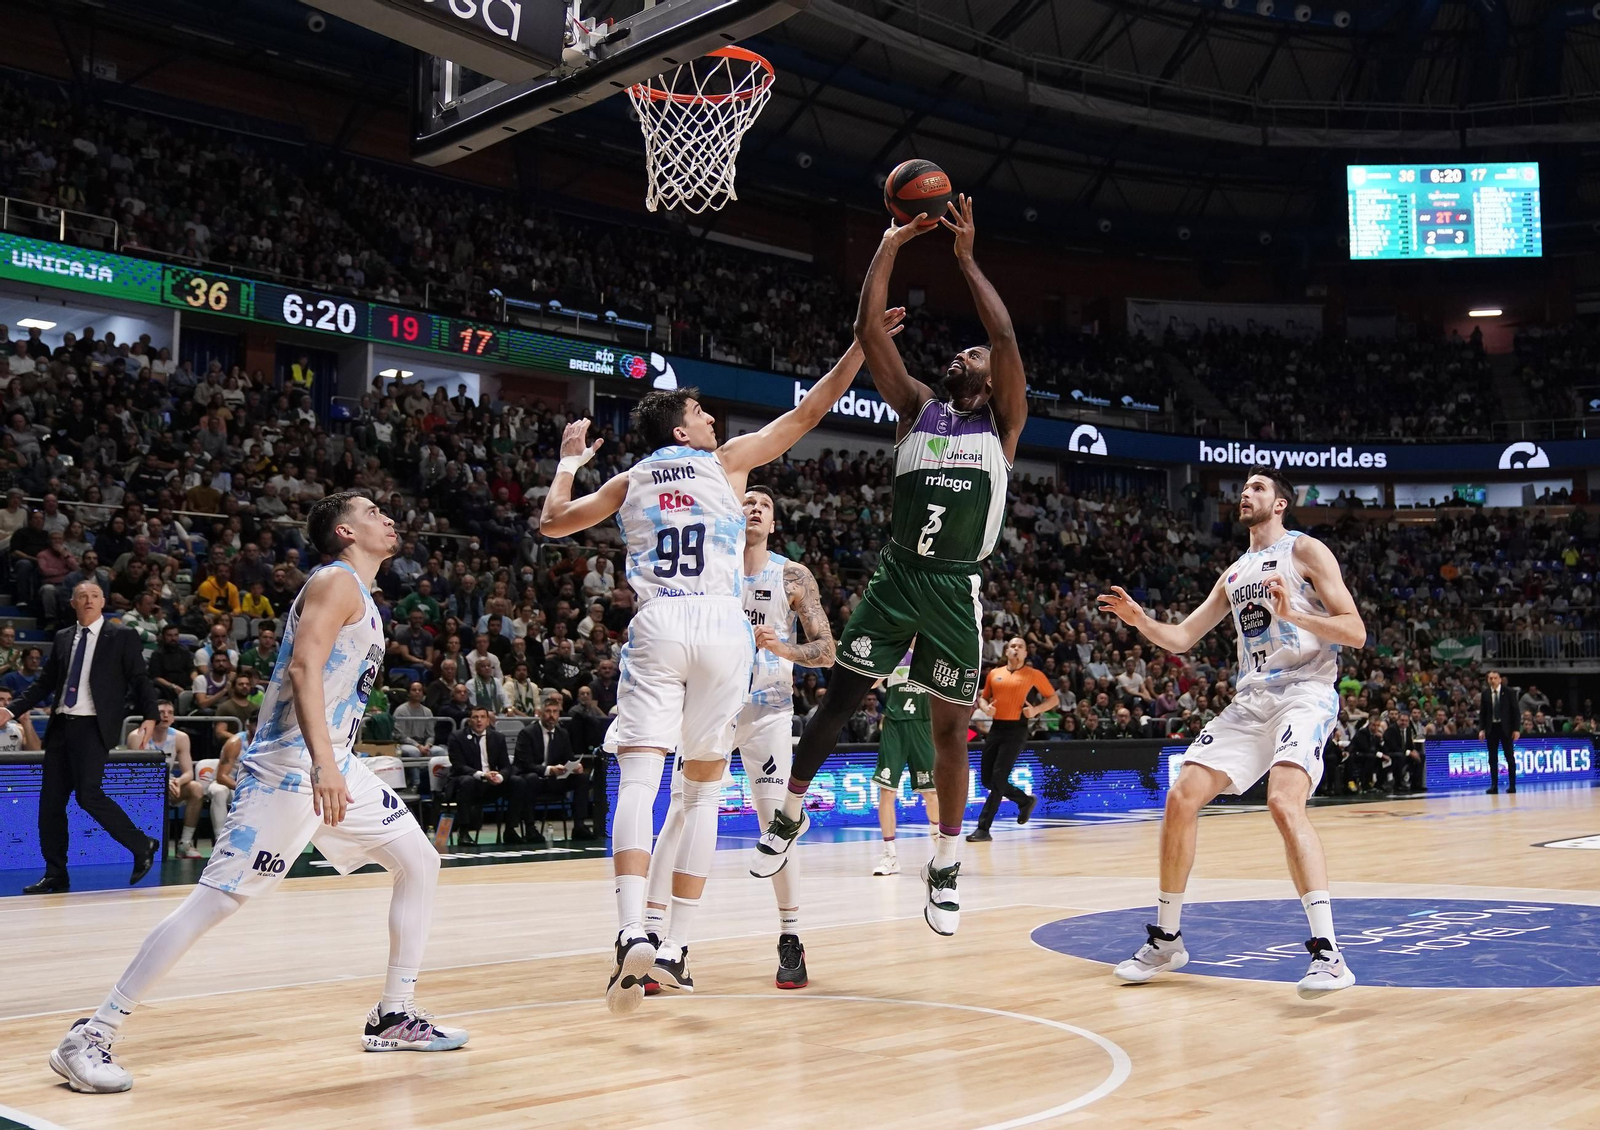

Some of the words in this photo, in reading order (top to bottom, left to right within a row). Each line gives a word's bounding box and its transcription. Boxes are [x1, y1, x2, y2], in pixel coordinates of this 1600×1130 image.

[1398, 169, 1416, 183] 36
[1430, 168, 1462, 183] 6:20
[1470, 168, 1487, 182] 17
[1436, 211, 1452, 224] 2T
[1427, 230, 1437, 245] 2
[1454, 230, 1464, 244] 3
[11, 249, 113, 283] UNICAJA
[186, 277, 230, 311] 36
[282, 293, 357, 334] 6:20
[388, 313, 419, 342] 19
[459, 327, 494, 355] 17
[569, 358, 615, 375] BREOGÁN
[595, 348, 615, 363] RÍO
[946, 449, 983, 462] Unicaja
[1199, 440, 1388, 470] holidayworld.es
[651, 462, 696, 485] NAKIĆ
[653, 522, 706, 578] 99
[1240, 610, 1264, 623] Estrella
[903, 698, 917, 714] 4
[1448, 751, 1510, 778] REDS
[1513, 748, 1591, 775] SOCIALES
[755, 777, 784, 785] CANDELAS
[382, 807, 411, 826] CANDEL
[252, 850, 286, 874] Río
[1378, 925, 1552, 955] HOTEL
